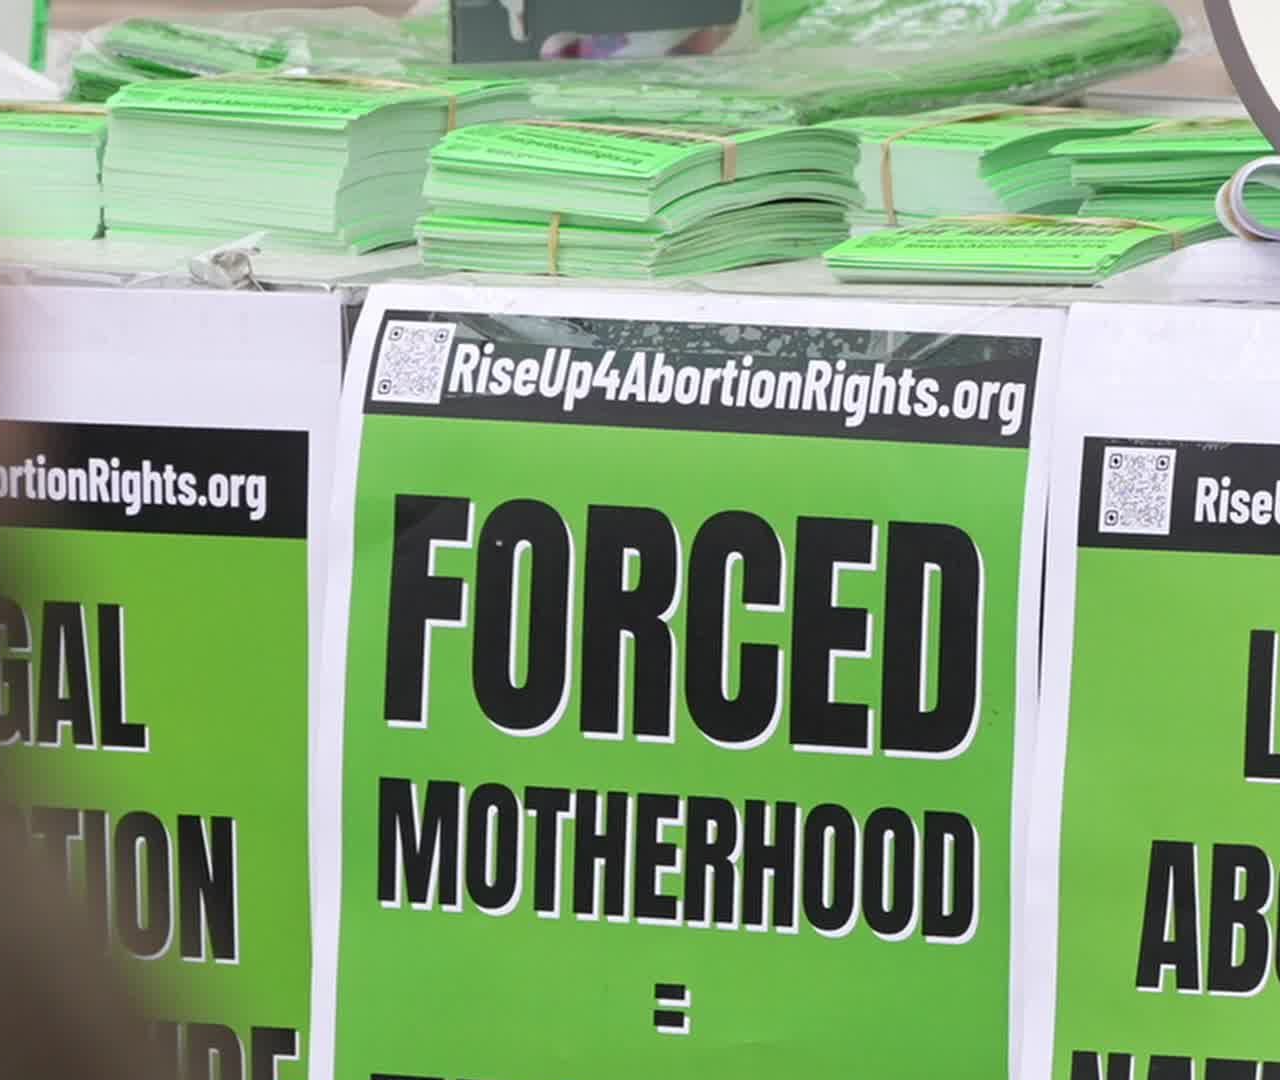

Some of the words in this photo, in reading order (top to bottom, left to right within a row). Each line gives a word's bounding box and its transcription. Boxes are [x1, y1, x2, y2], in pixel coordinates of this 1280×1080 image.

[449, 343, 1025, 436] RiseUp4AbortionRights.org
[384, 493, 983, 760] FORCED
[31, 805, 240, 966] TION
[377, 776, 979, 944] MOTHERHOOD
[653, 983, 691, 1034] =
